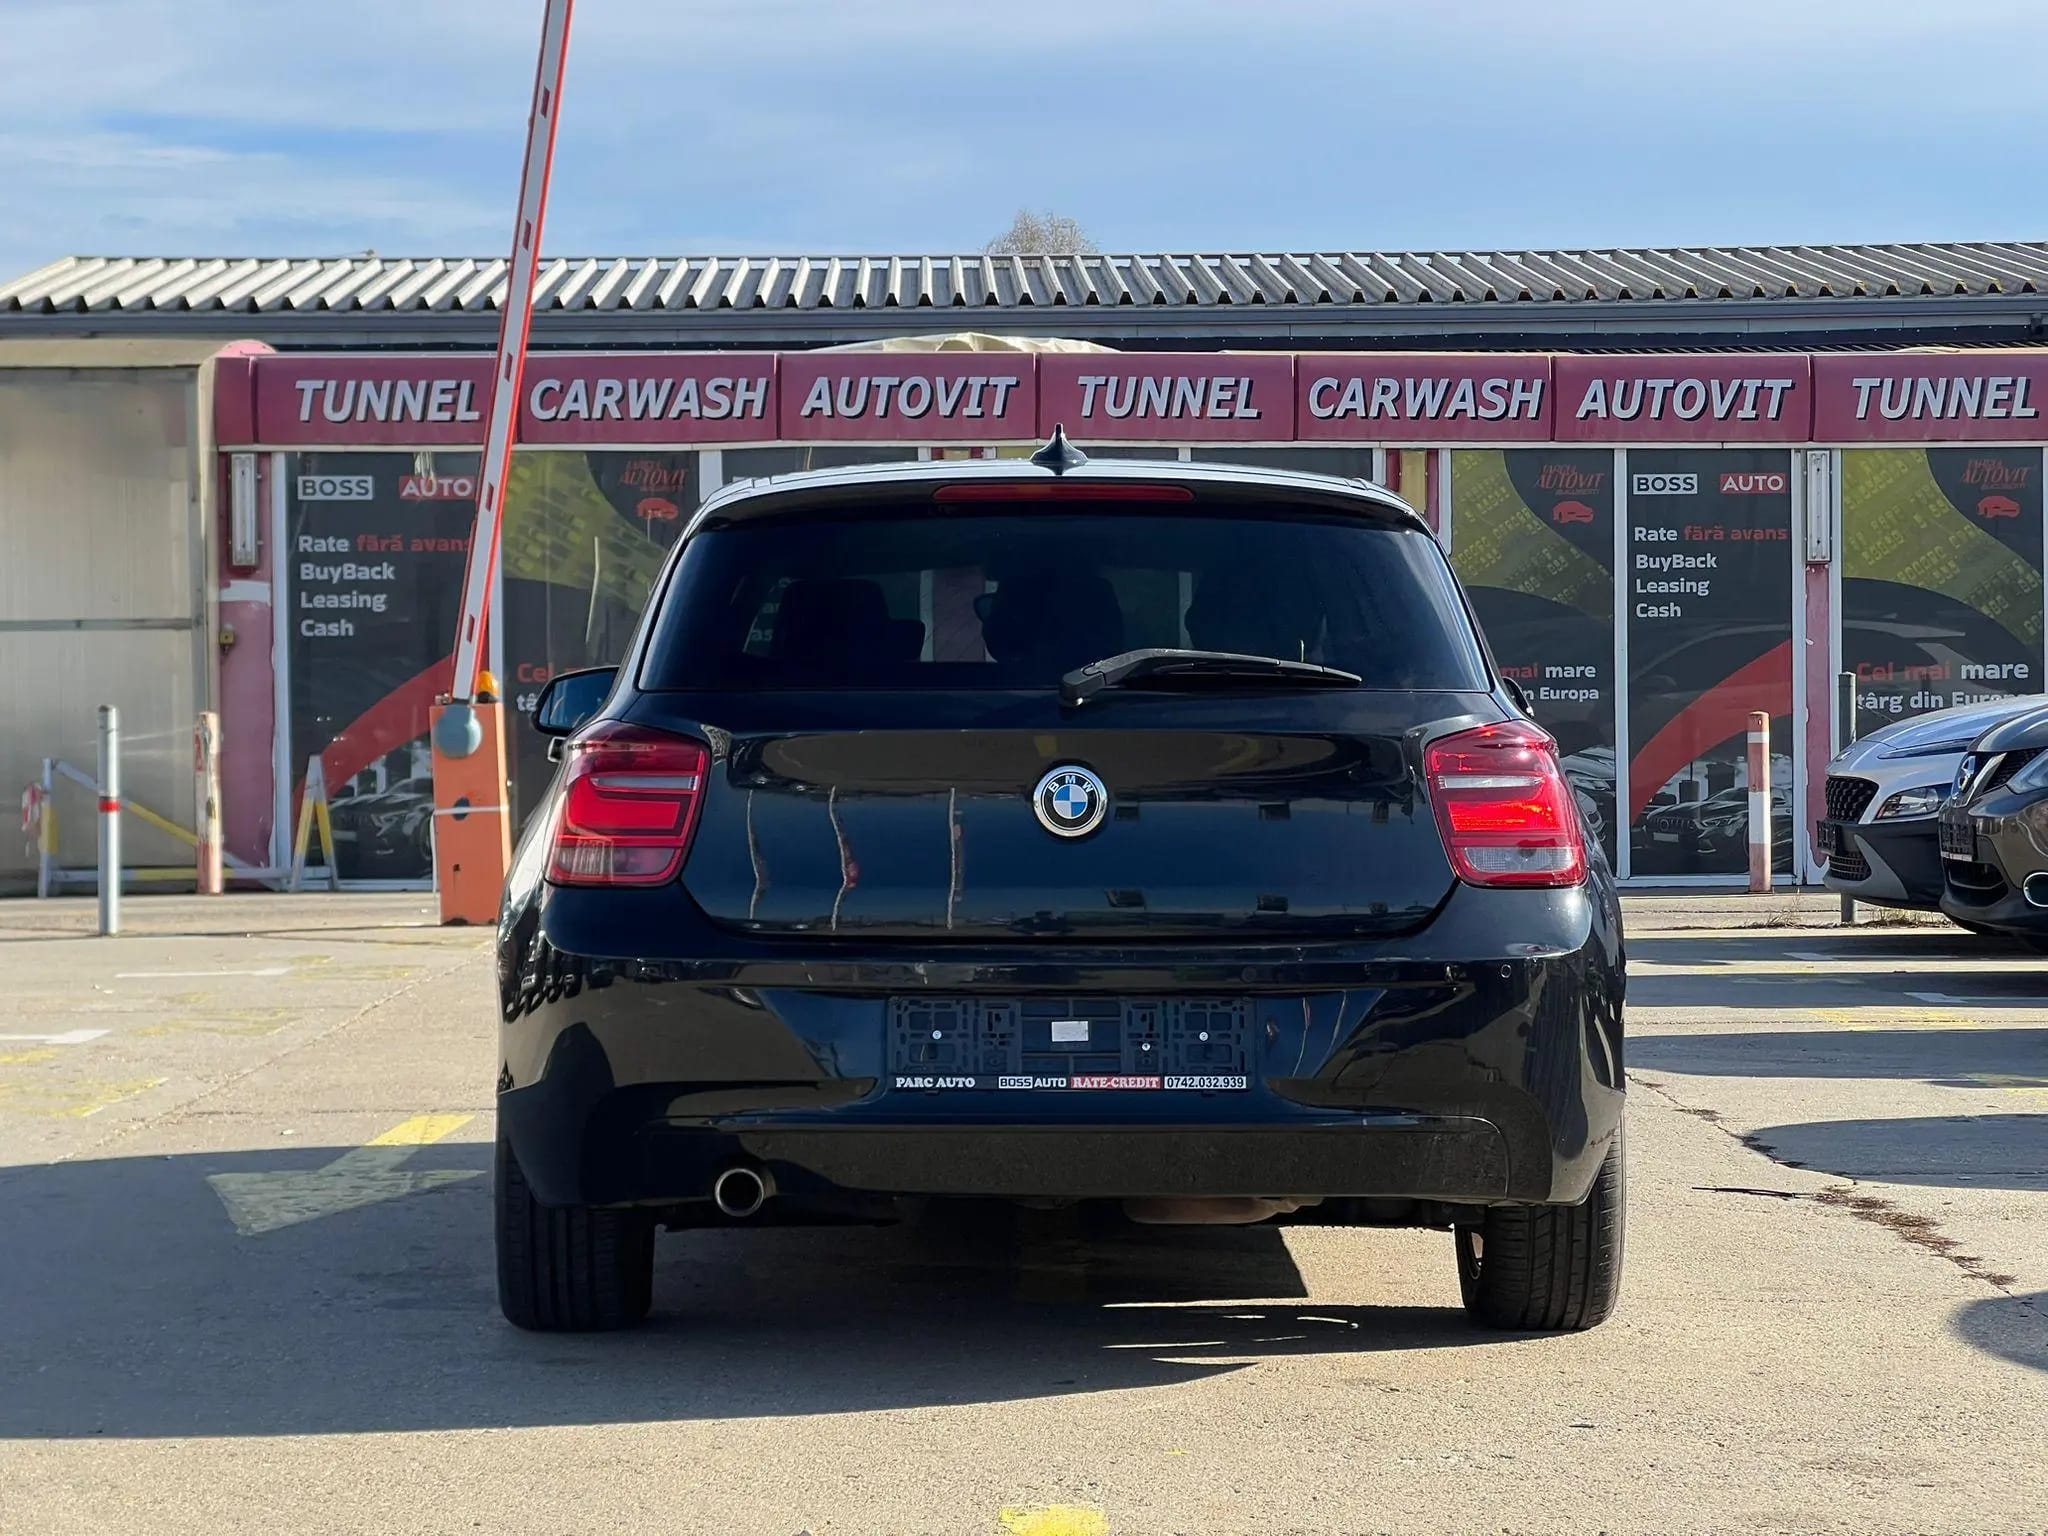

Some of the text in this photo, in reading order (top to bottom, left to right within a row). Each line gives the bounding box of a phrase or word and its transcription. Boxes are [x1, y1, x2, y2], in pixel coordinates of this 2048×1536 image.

[295, 375, 2039, 422] TUNNEL CARWASH AUTOVIT TUNNEL CARWASH AUTOVIT TUNNEL
[302, 478, 472, 496] BOSS AUTO
[1637, 475, 1784, 492] BOSS AUTO
[1634, 527, 1678, 541] Rate
[1730, 528, 1788, 541] avans
[299, 535, 350, 552] Rate
[1636, 553, 1718, 572] BuyBack
[301, 562, 395, 583] BuyBack
[1636, 578, 1710, 596] Leasing
[301, 591, 388, 612] Leasing
[1636, 603, 1682, 618] Cash
[301, 619, 354, 636] Cash
[1545, 665, 1597, 679] mare
[1857, 662, 2029, 682] Cel mai mare
[1540, 687, 1600, 703] Europa
[1857, 691, 2031, 713] târg din Euro
[1047, 775, 1094, 793] BMW
[896, 1076, 1245, 1089] PARC AUTO BOSS AUTO RATE-CREDIT 0742.032.939
